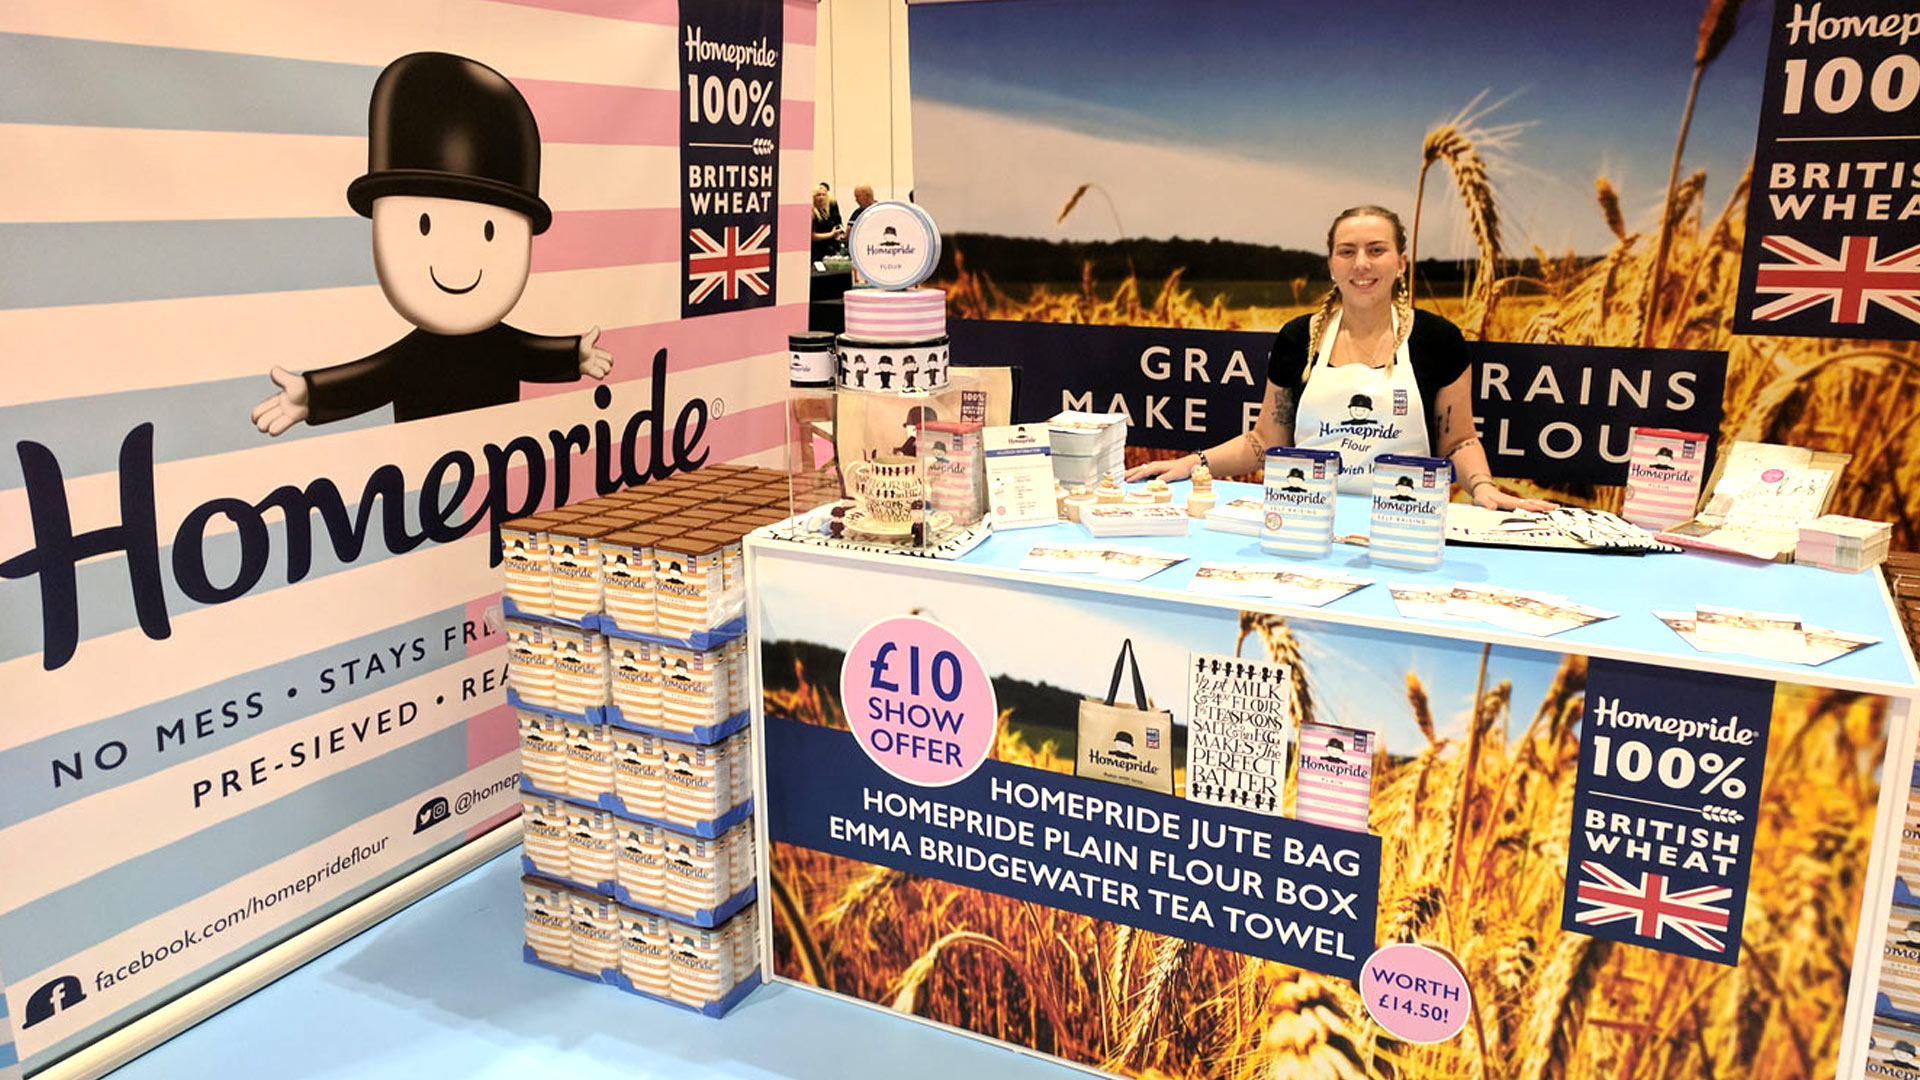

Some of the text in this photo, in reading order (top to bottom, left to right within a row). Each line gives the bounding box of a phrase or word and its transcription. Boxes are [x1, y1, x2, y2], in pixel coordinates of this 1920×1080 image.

[685, 24, 776, 71] Homepride
[688, 73, 776, 127] 100%
[688, 164, 773, 188] BRITISH
[689, 191, 771, 215] WHEAT
[866, 243, 915, 256] Homepride
[1140, 345, 1697, 411] GRA RAINS
[1062, 389, 1207, 432] MAKE
[1340, 437, 1371, 453] Flour
[1631, 463, 1694, 482] Homepride
[1265, 487, 1327, 505] Homepride
[1373, 495, 1436, 514] Homepride
[870, 641, 963, 702] £10
[1231, 679, 1282, 701] MILK
[51, 740, 128, 789] NO
[156, 692, 264, 752] MESS
[319, 638, 426, 694] STAYS
[868, 696, 964, 735] SHOW
[1232, 695, 1281, 716] FLOUR
[1593, 695, 1755, 747] Homepride
[1192, 719, 1228, 736] SALT
[1193, 733, 1254, 755] MAKES
[192, 701, 418, 808] PRE-SIEVED
[870, 728, 963, 768] OFFER
[1088, 748, 1159, 776] Homepride
[1192, 747, 1281, 777] PERFECT
[1300, 754, 1368, 779] Homepride
[1192, 764, 1277, 797] BATTER
[1593, 734, 1747, 800] 100%
[990, 776, 1361, 877] HOMEPRIDE JUTE BAG
[1585, 808, 1740, 855] BRITISH
[863, 787, 1358, 920] HOMEPRIDE PLAIN FLOUR BOX
[1584, 830, 1736, 877] WHEAT
[830, 815, 1356, 961] EMMA BRIDGEWATER TEA TOWEL
[94, 834, 390, 993] facebook.com/homeprideflour
[1371, 967, 1460, 1002] WORTH
[1378, 993, 1449, 1024] £14.50!
